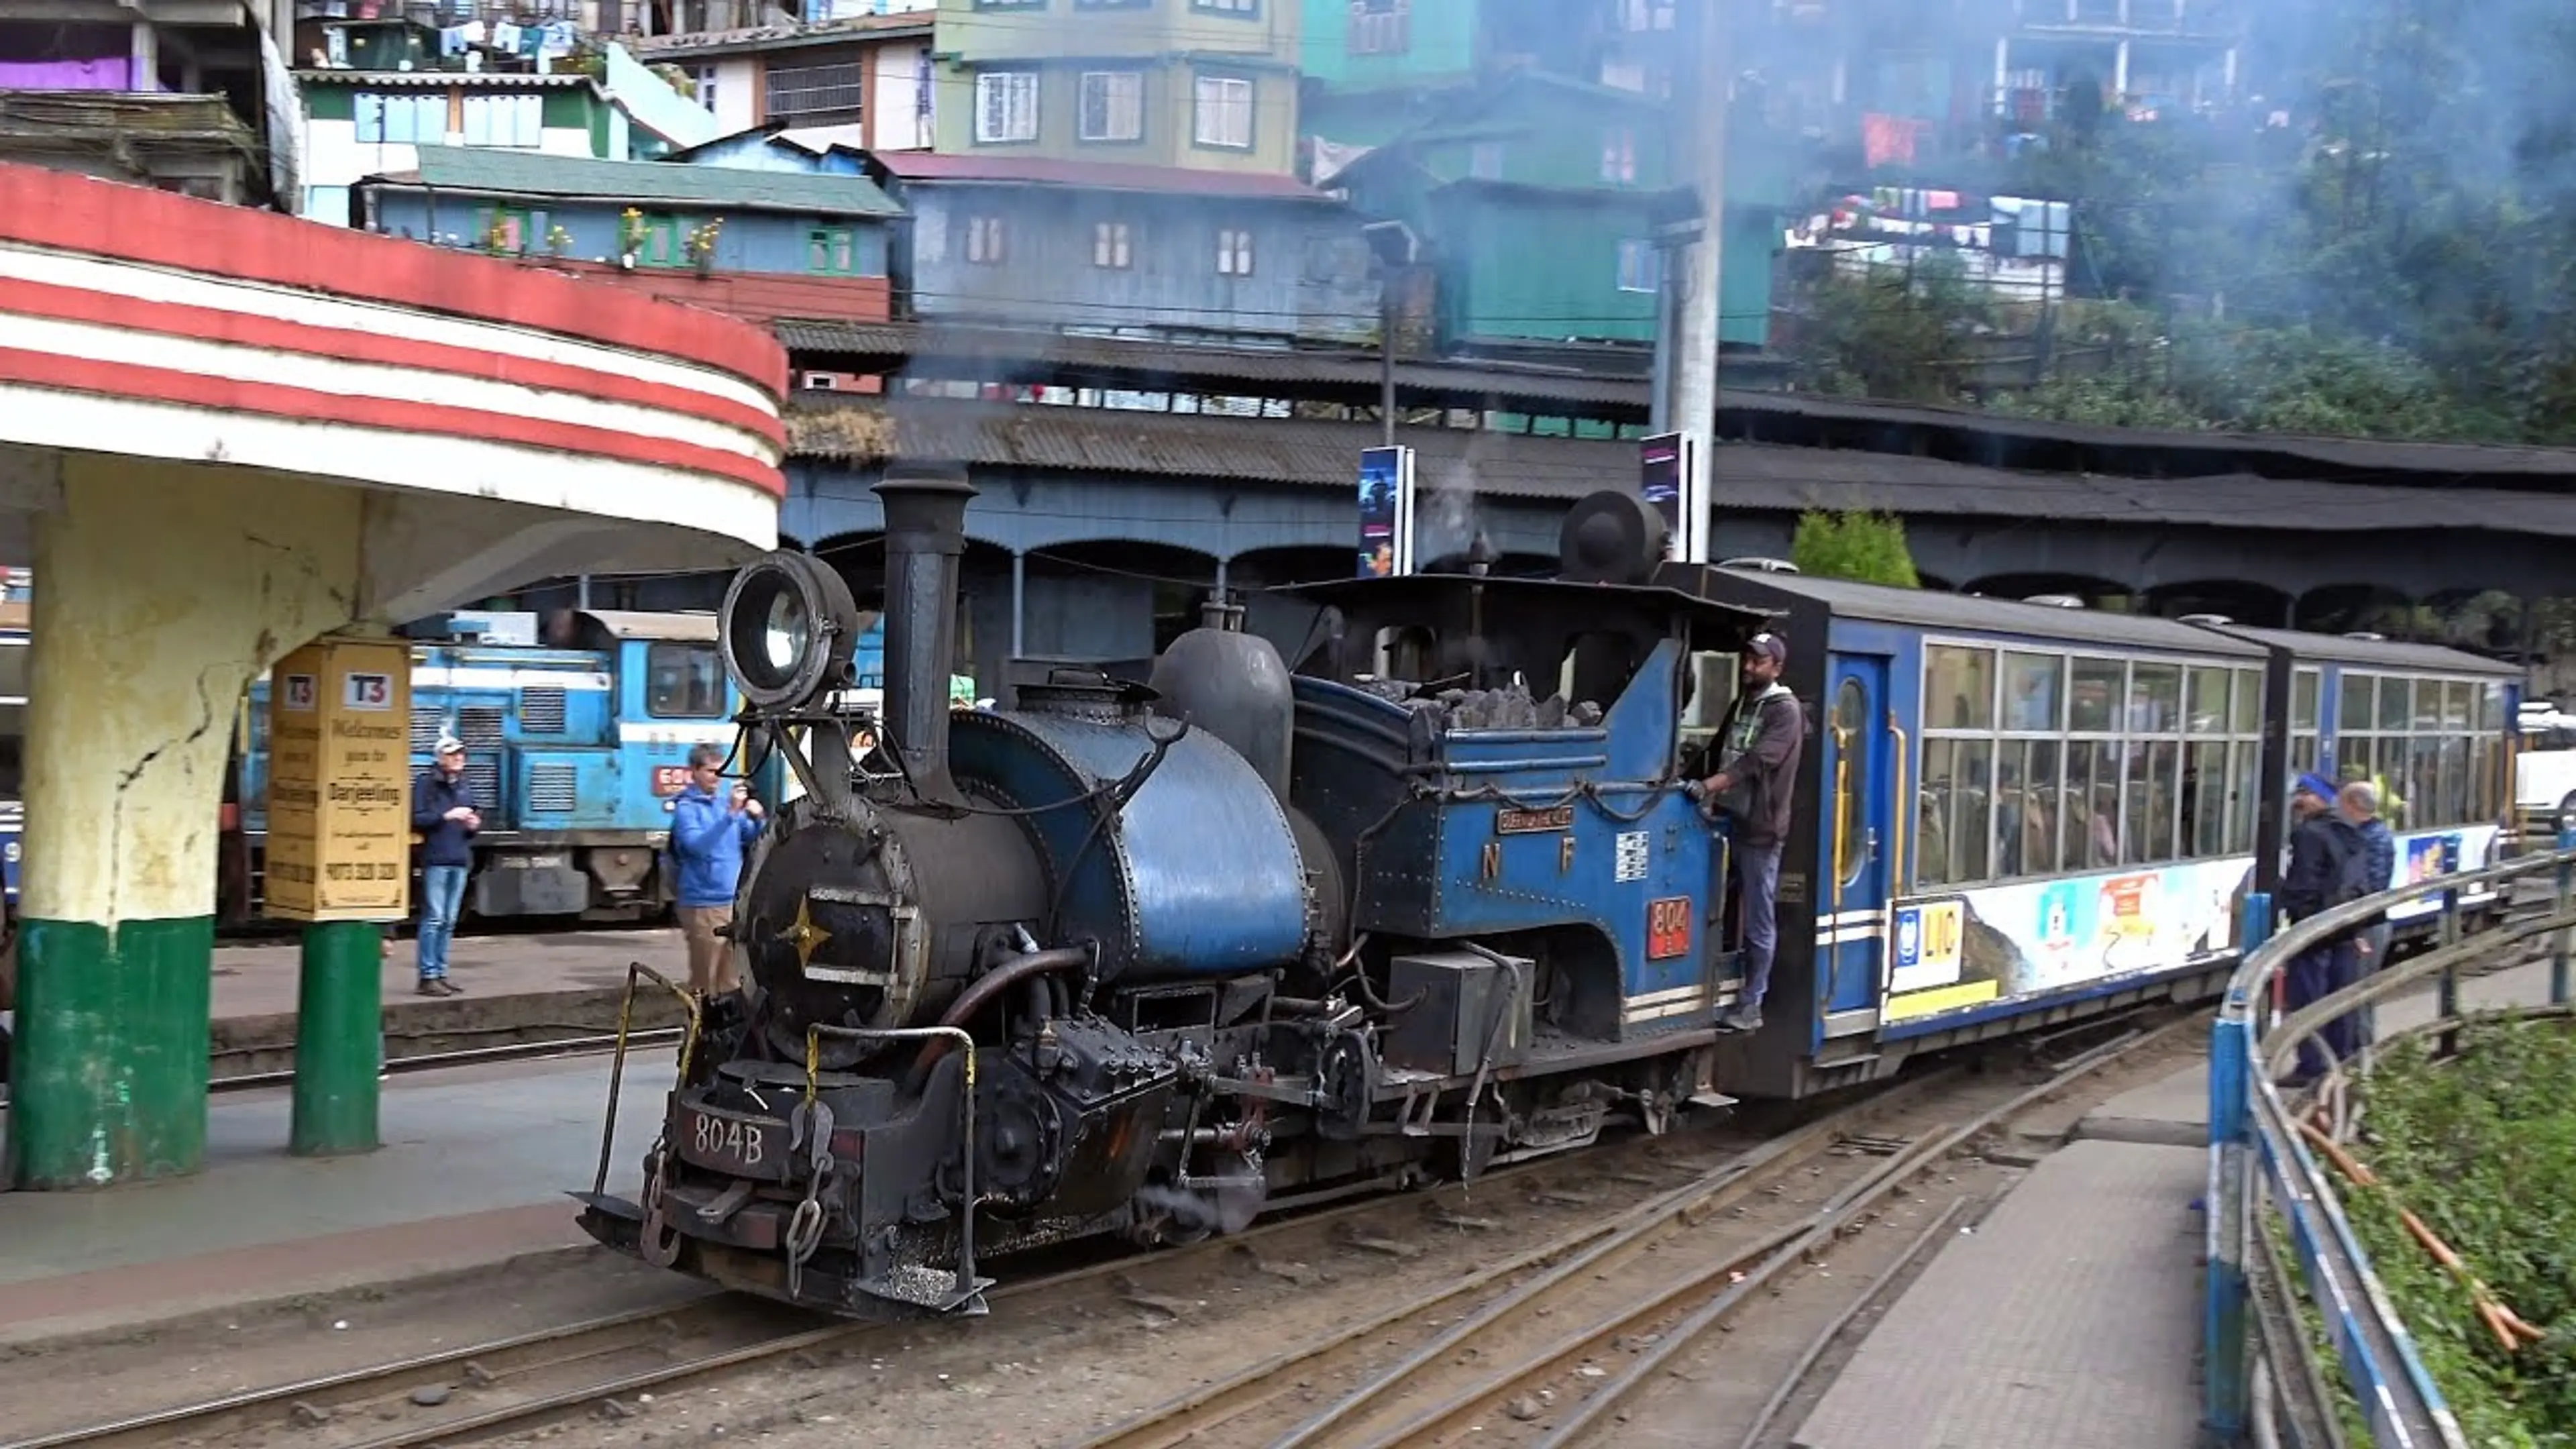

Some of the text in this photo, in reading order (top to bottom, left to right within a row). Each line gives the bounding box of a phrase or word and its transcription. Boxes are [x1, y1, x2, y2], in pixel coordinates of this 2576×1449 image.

[288, 676, 313, 703] T3
[351, 675, 386, 703] T3
[329, 782, 400, 806] Darjeeling
[1483, 842, 1501, 881] N
[1561, 837, 1576, 872] F
[1654, 902, 1686, 934] 804
[696, 1114, 763, 1165] 804B
